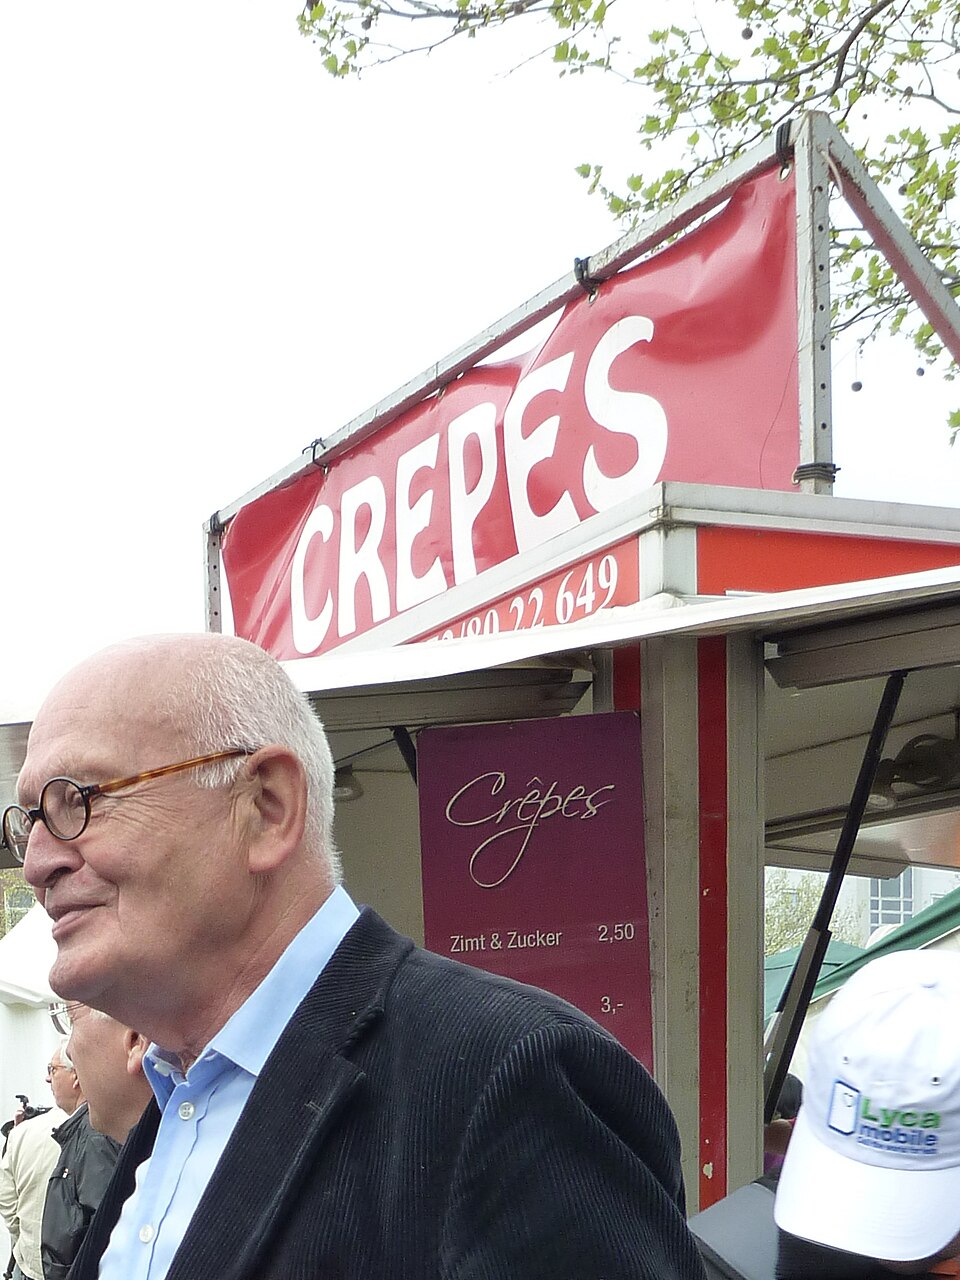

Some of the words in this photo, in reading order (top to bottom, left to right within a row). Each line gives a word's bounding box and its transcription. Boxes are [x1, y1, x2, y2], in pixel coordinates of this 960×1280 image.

[291, 316, 668, 655] CREPES
[509, 587, 545, 631] 22
[556, 555, 618, 624] 649
[445, 772, 615, 888] Crêpes
[450, 935, 486, 952] Zimt
[490, 932, 503, 950] &
[507, 930, 563, 949] Zucker
[598, 923, 635, 943] 2,50
[600, 996, 624, 1015] 3,-
[861, 1096, 941, 1128] Lyca
[859, 1123, 938, 1146] mobile
